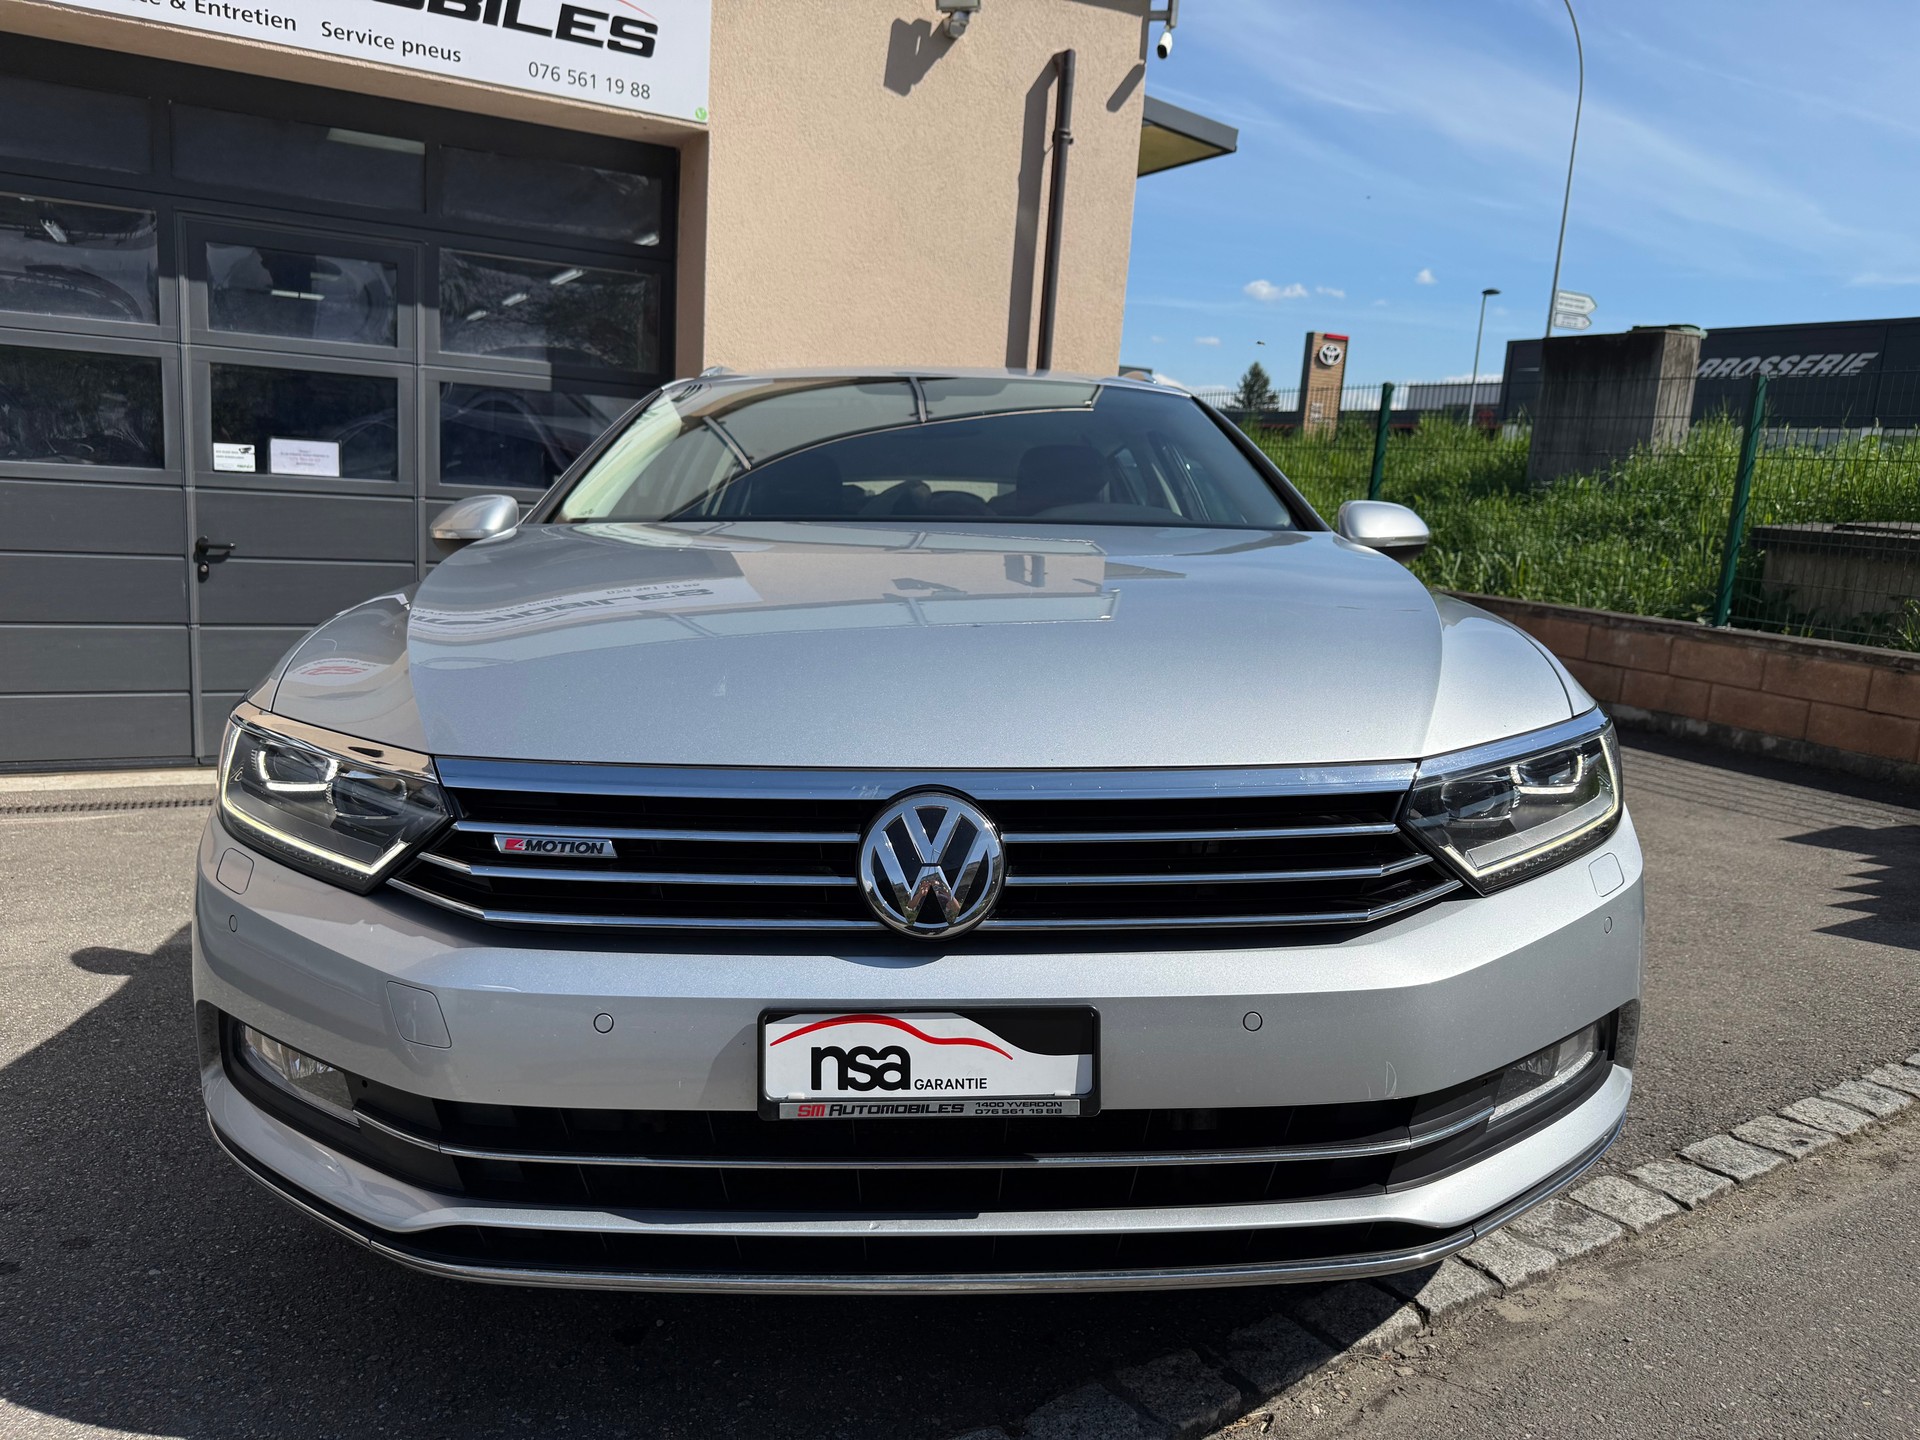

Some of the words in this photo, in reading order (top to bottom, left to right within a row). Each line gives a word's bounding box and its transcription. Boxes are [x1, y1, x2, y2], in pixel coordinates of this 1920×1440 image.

[194, 0, 297, 31] Entretien
[321, 21, 395, 50] Service
[402, 40, 462, 63] pneus
[528, 61, 561, 82] 076
[567, 69, 596, 89] 561
[606, 77, 625, 95] 19
[630, 82, 651, 100] 88
[1696, 352, 1880, 379] RROSSERIE
[512, 838, 605, 855] 4MOTION
[810, 1045, 911, 1092] nsa
[914, 1077, 988, 1091] GARANTIE
[797, 1103, 826, 1117] SM
[828, 1103, 965, 1117] AUTOMOBILES
